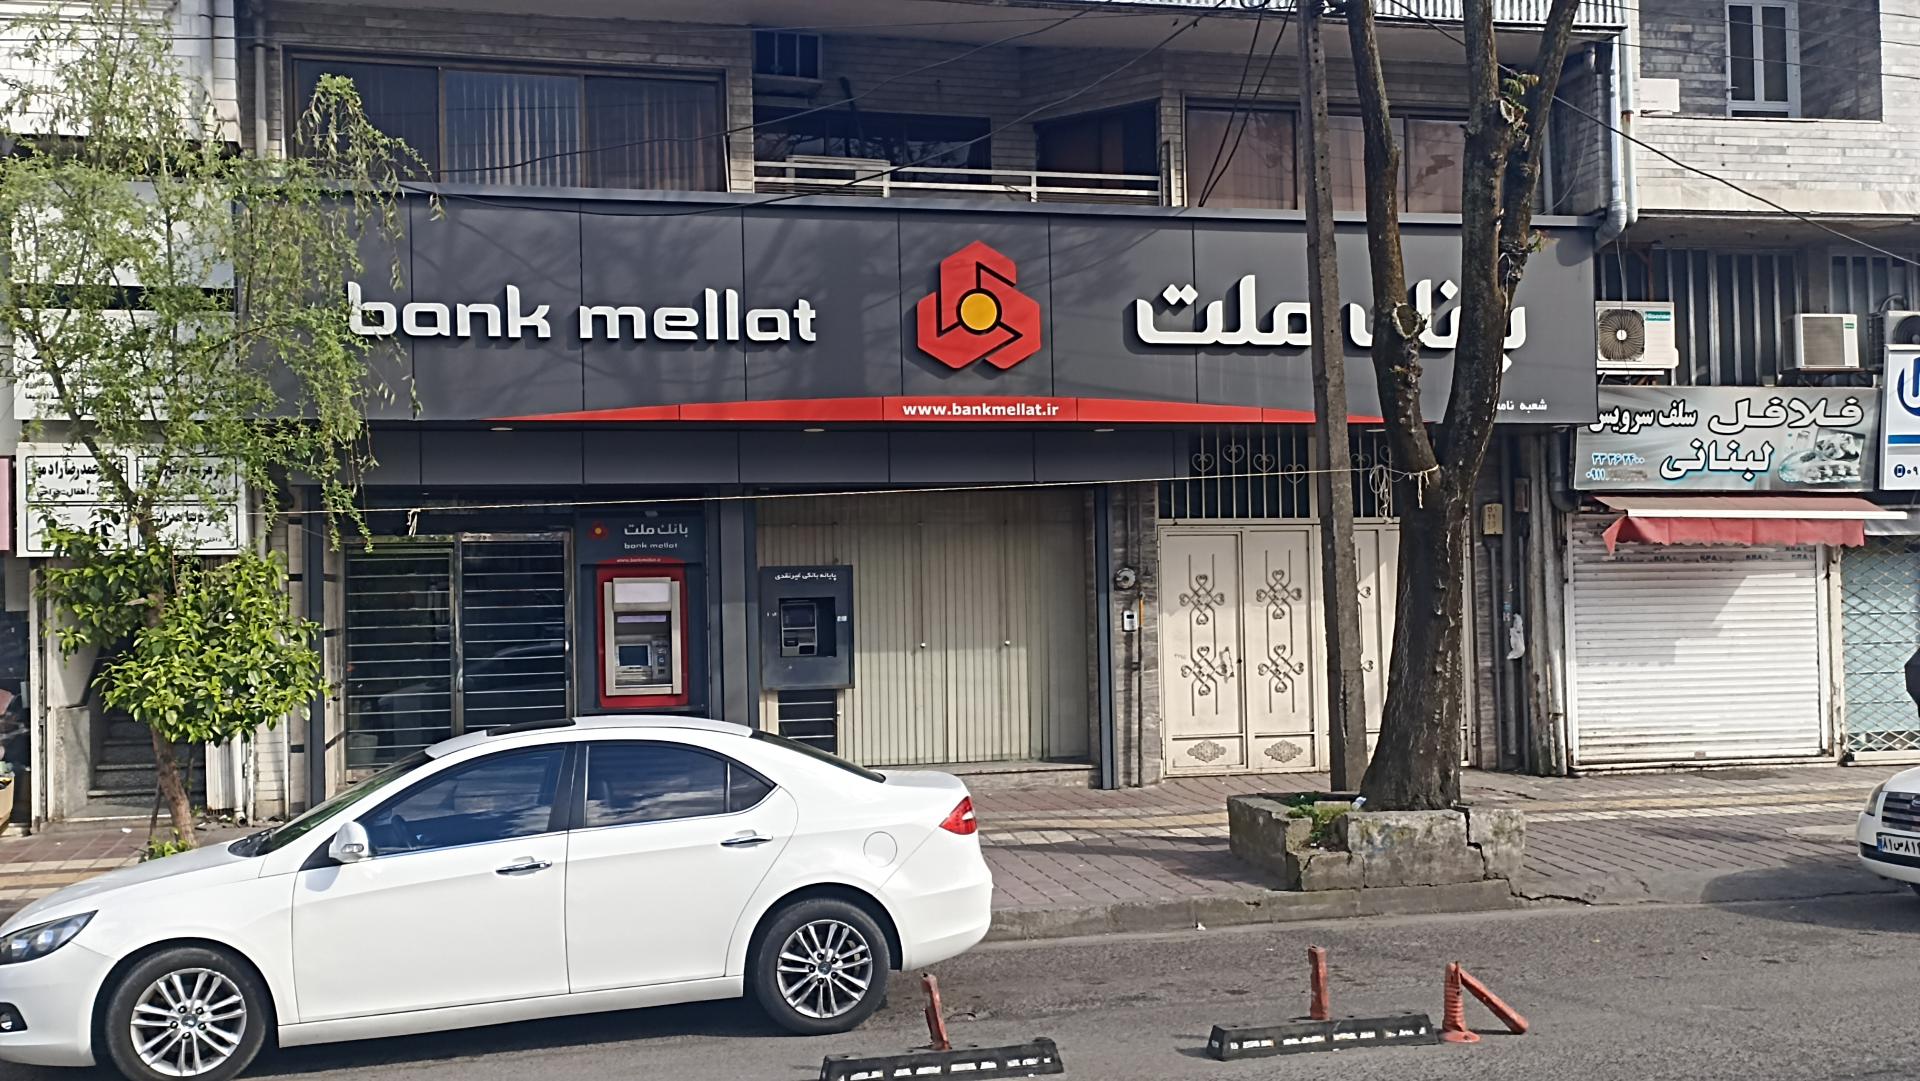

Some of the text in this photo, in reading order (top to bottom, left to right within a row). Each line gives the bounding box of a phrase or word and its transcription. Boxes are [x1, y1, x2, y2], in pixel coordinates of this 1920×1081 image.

[347, 281, 816, 342] bank mellat
[1137, 275, 1312, 346] ملت
[902, 402, 1060, 417] www.bankmellat.ir
[1519, 398, 1548, 413] شعبه
[1588, 396, 1865, 435] فلافل سلف سرویس
[1659, 437, 1775, 482] لبنانی
[624, 524, 655, 535] ملت
[624, 541, 647, 549] bank
[802, 572, 819, 580] بانکی
[819, 572, 837, 581] پایانه
